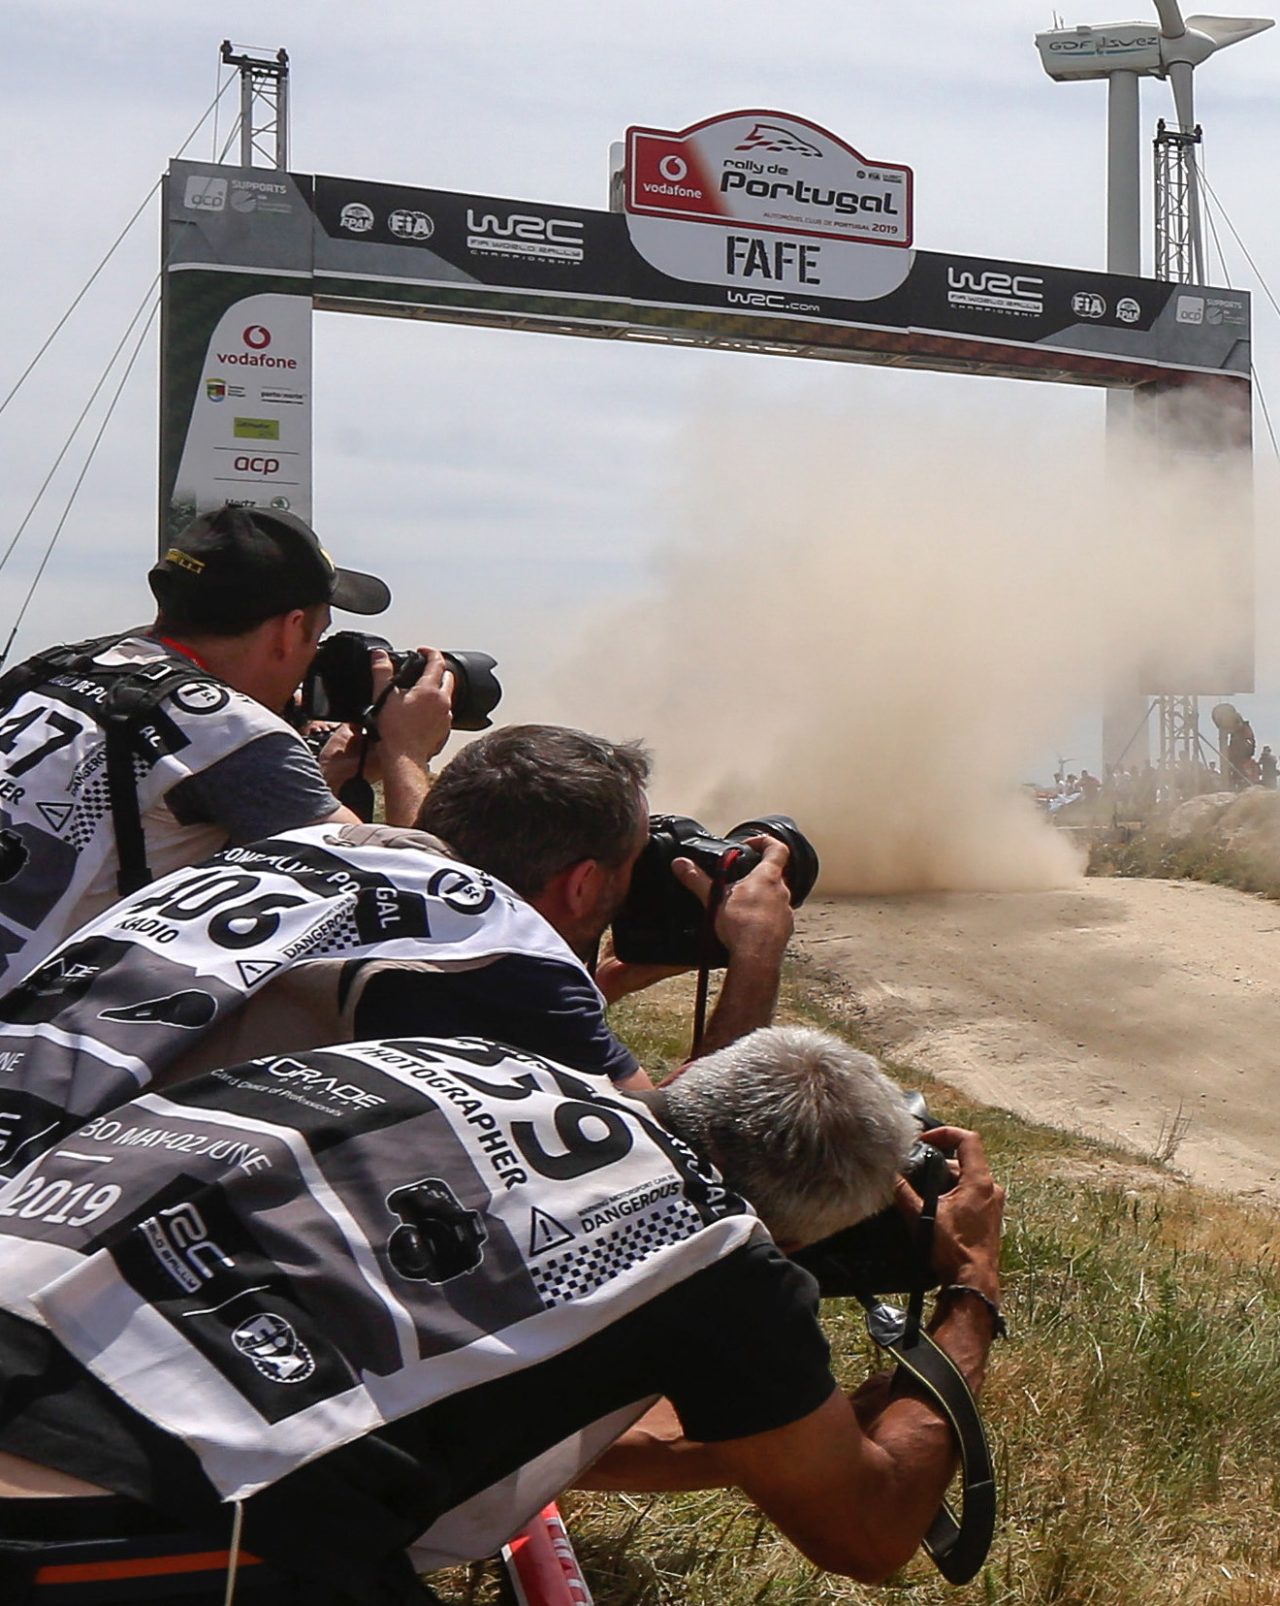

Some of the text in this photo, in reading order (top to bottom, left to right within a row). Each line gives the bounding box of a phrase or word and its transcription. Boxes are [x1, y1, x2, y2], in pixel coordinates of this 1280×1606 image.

[723, 158, 789, 176] rally de
[231, 180, 287, 194] SUPPORTS
[643, 181, 702, 199] vodafone
[720, 170, 898, 215] Portugal
[467, 209, 583, 244] WRC
[833, 220, 870, 231] PORTUGAL
[871, 223, 898, 234] 2019
[491, 240, 535, 252] WORLD
[540, 244, 582, 258] RALLY
[726, 235, 821, 285] FAFE
[948, 267, 1043, 299] WRC
[217, 352, 297, 369] vodafone
[234, 456, 279, 475] acp
[210, 1068, 239, 1085] Card
[346, 1046, 527, 1190] PHOTOGRAPHER
[78, 1117, 122, 1140] 30
[196, 1139, 272, 1177] JUNE
[3, 1175, 122, 1227] 2019
[608, 1181, 653, 1202] MOTORSPORT
[653, 1176, 667, 1185] CAN
[581, 1181, 680, 1233] DANGEROUS
